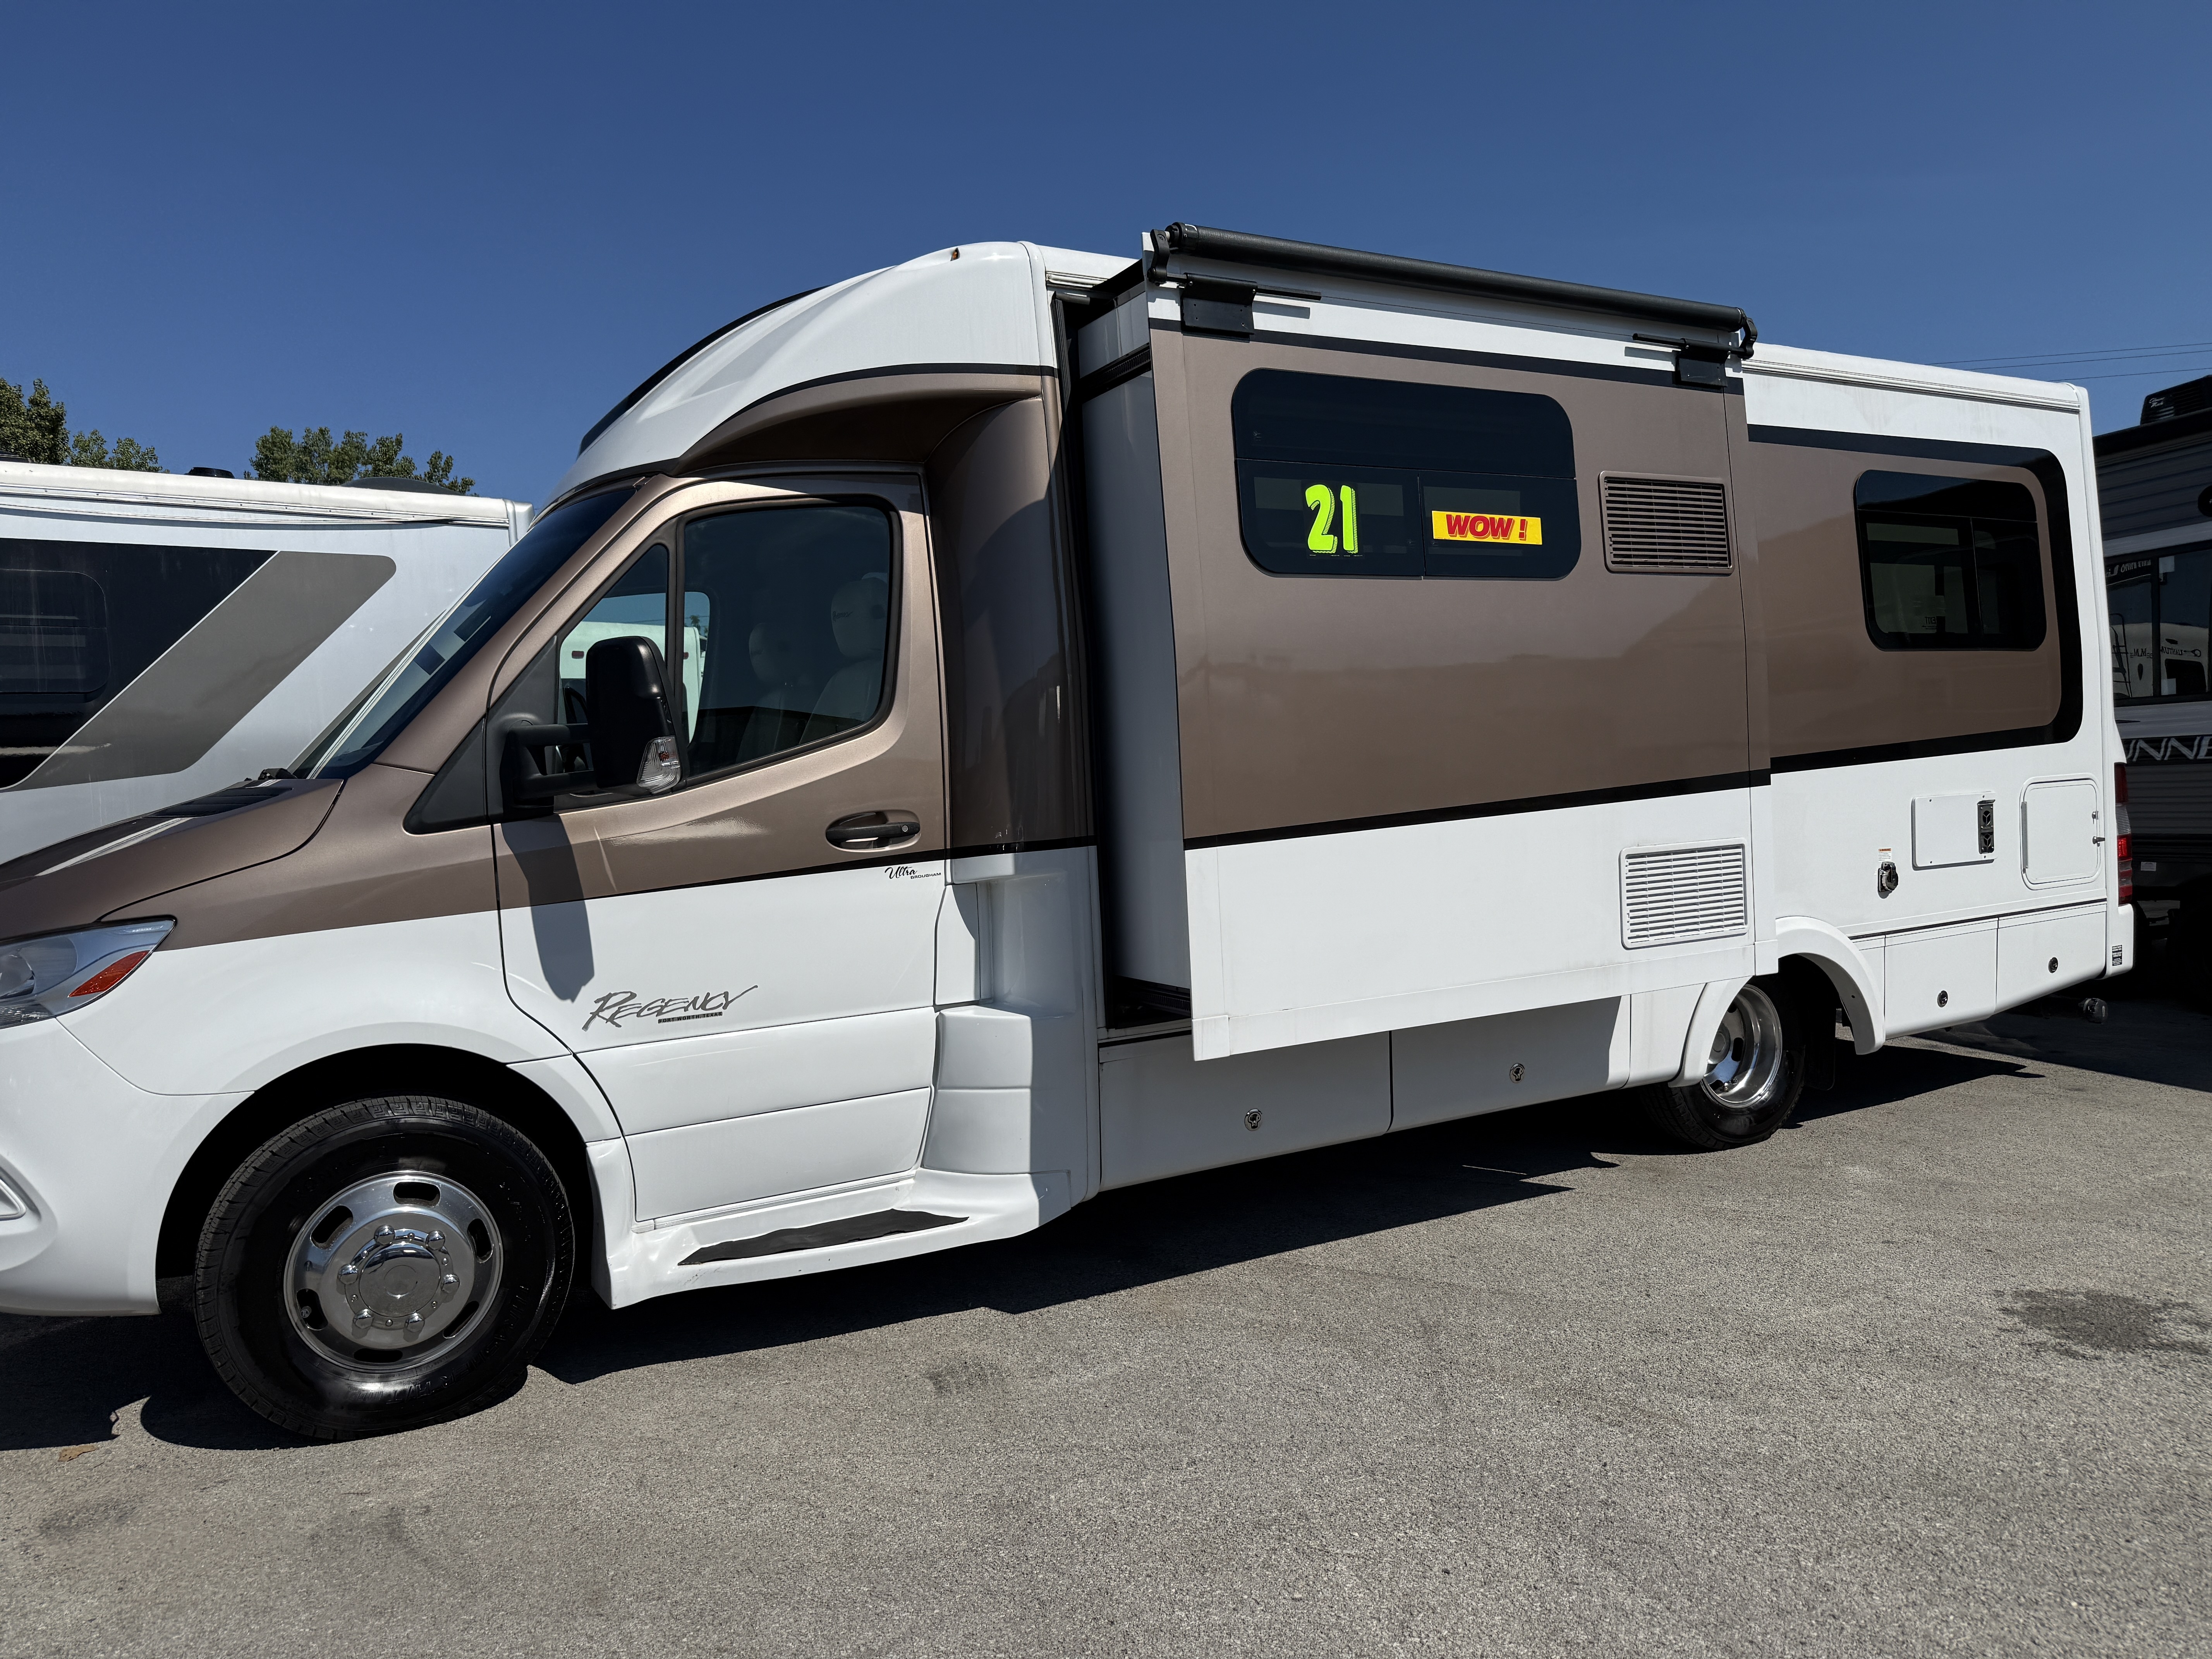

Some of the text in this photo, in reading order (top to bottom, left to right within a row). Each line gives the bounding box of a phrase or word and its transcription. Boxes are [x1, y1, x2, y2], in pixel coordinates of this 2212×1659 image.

[1305, 484, 1358, 553] 21
[884, 866, 917, 879] Ultra
[582, 985, 758, 1032] REGENCY
